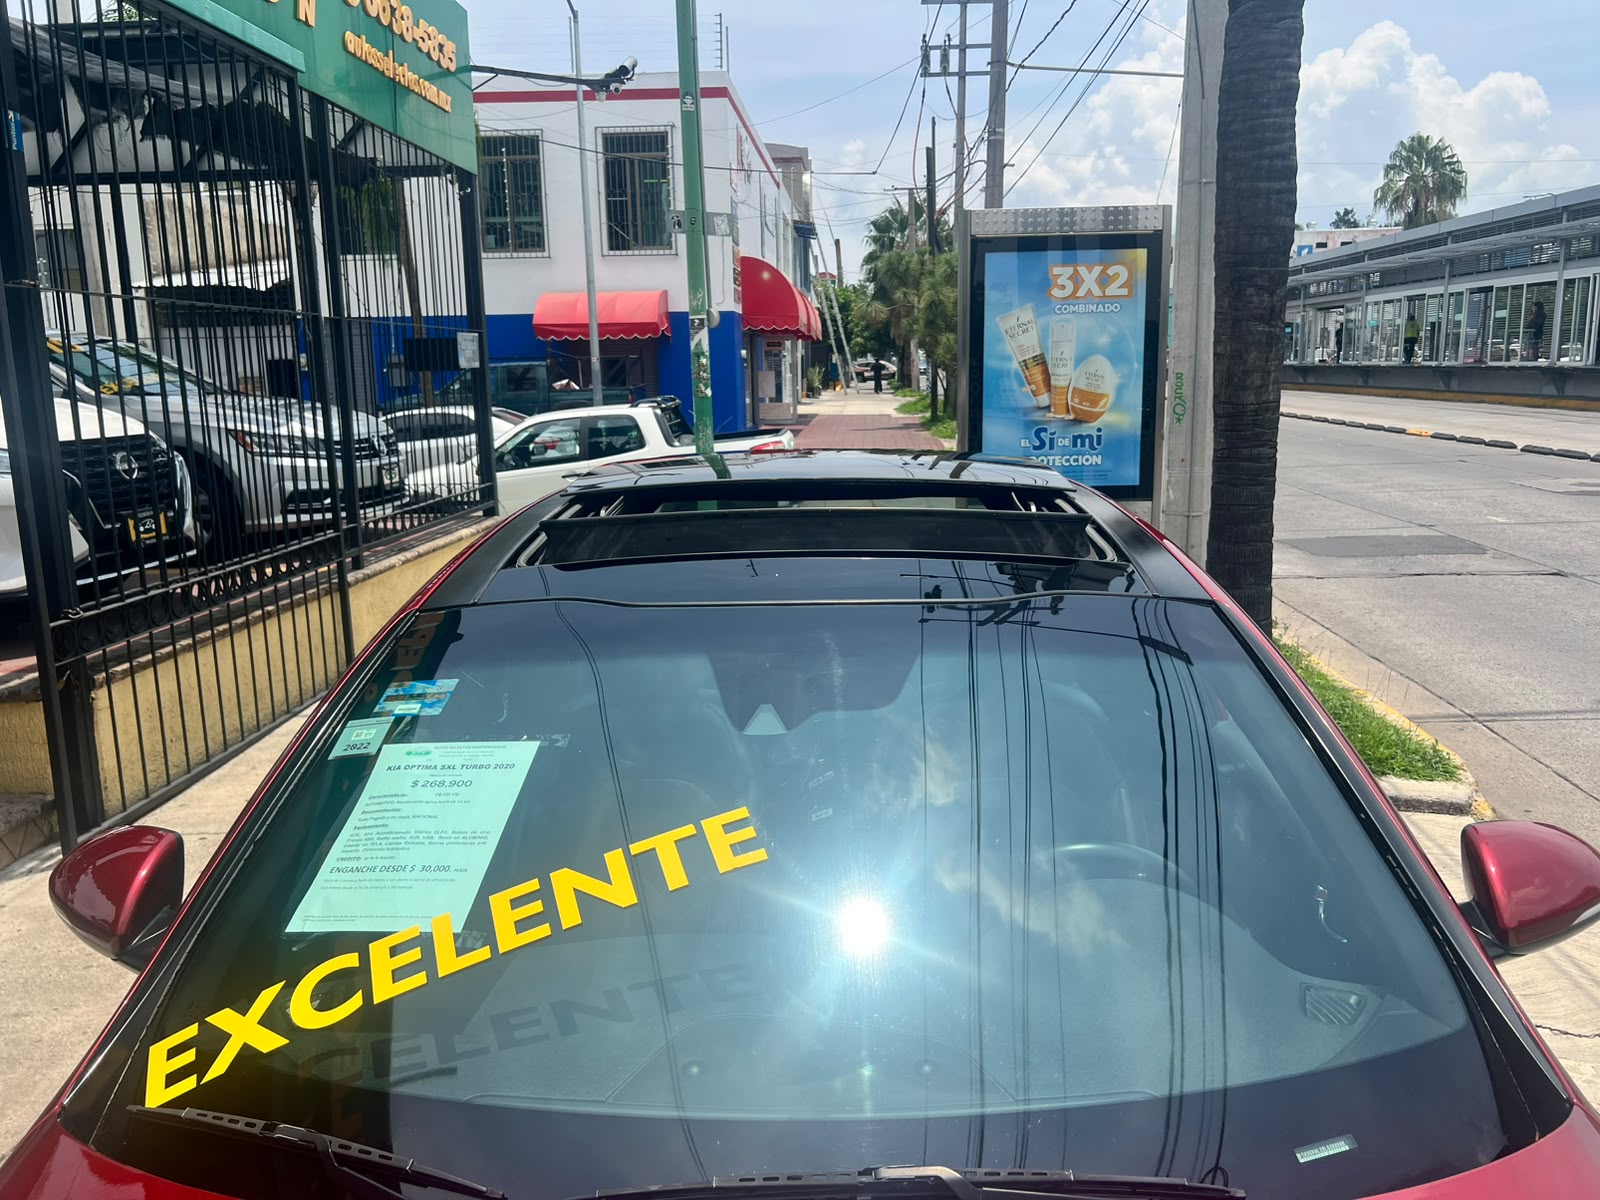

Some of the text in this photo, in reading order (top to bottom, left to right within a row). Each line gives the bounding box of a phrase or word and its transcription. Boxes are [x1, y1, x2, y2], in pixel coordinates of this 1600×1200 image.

[1050, 264, 1129, 298] 3X2
[1054, 303, 1121, 314] COMBINADO
[1020, 426, 1103, 452] EL Sí DE mi
[1029, 452, 1102, 466] OTECCIÓN
[343, 742, 371, 752] 2022
[386, 764, 401, 772] KIA
[404, 763, 437, 771] OPTIMA
[440, 763, 457, 771] SXL
[460, 763, 491, 771] TURBO
[410, 779, 473, 789] $ 268,900
[329, 864, 378, 874] ENGANCHE
[379, 864, 408, 873] DESDE
[409, 864, 416, 874] $
[144, 805, 769, 1109] EXCELENTE
